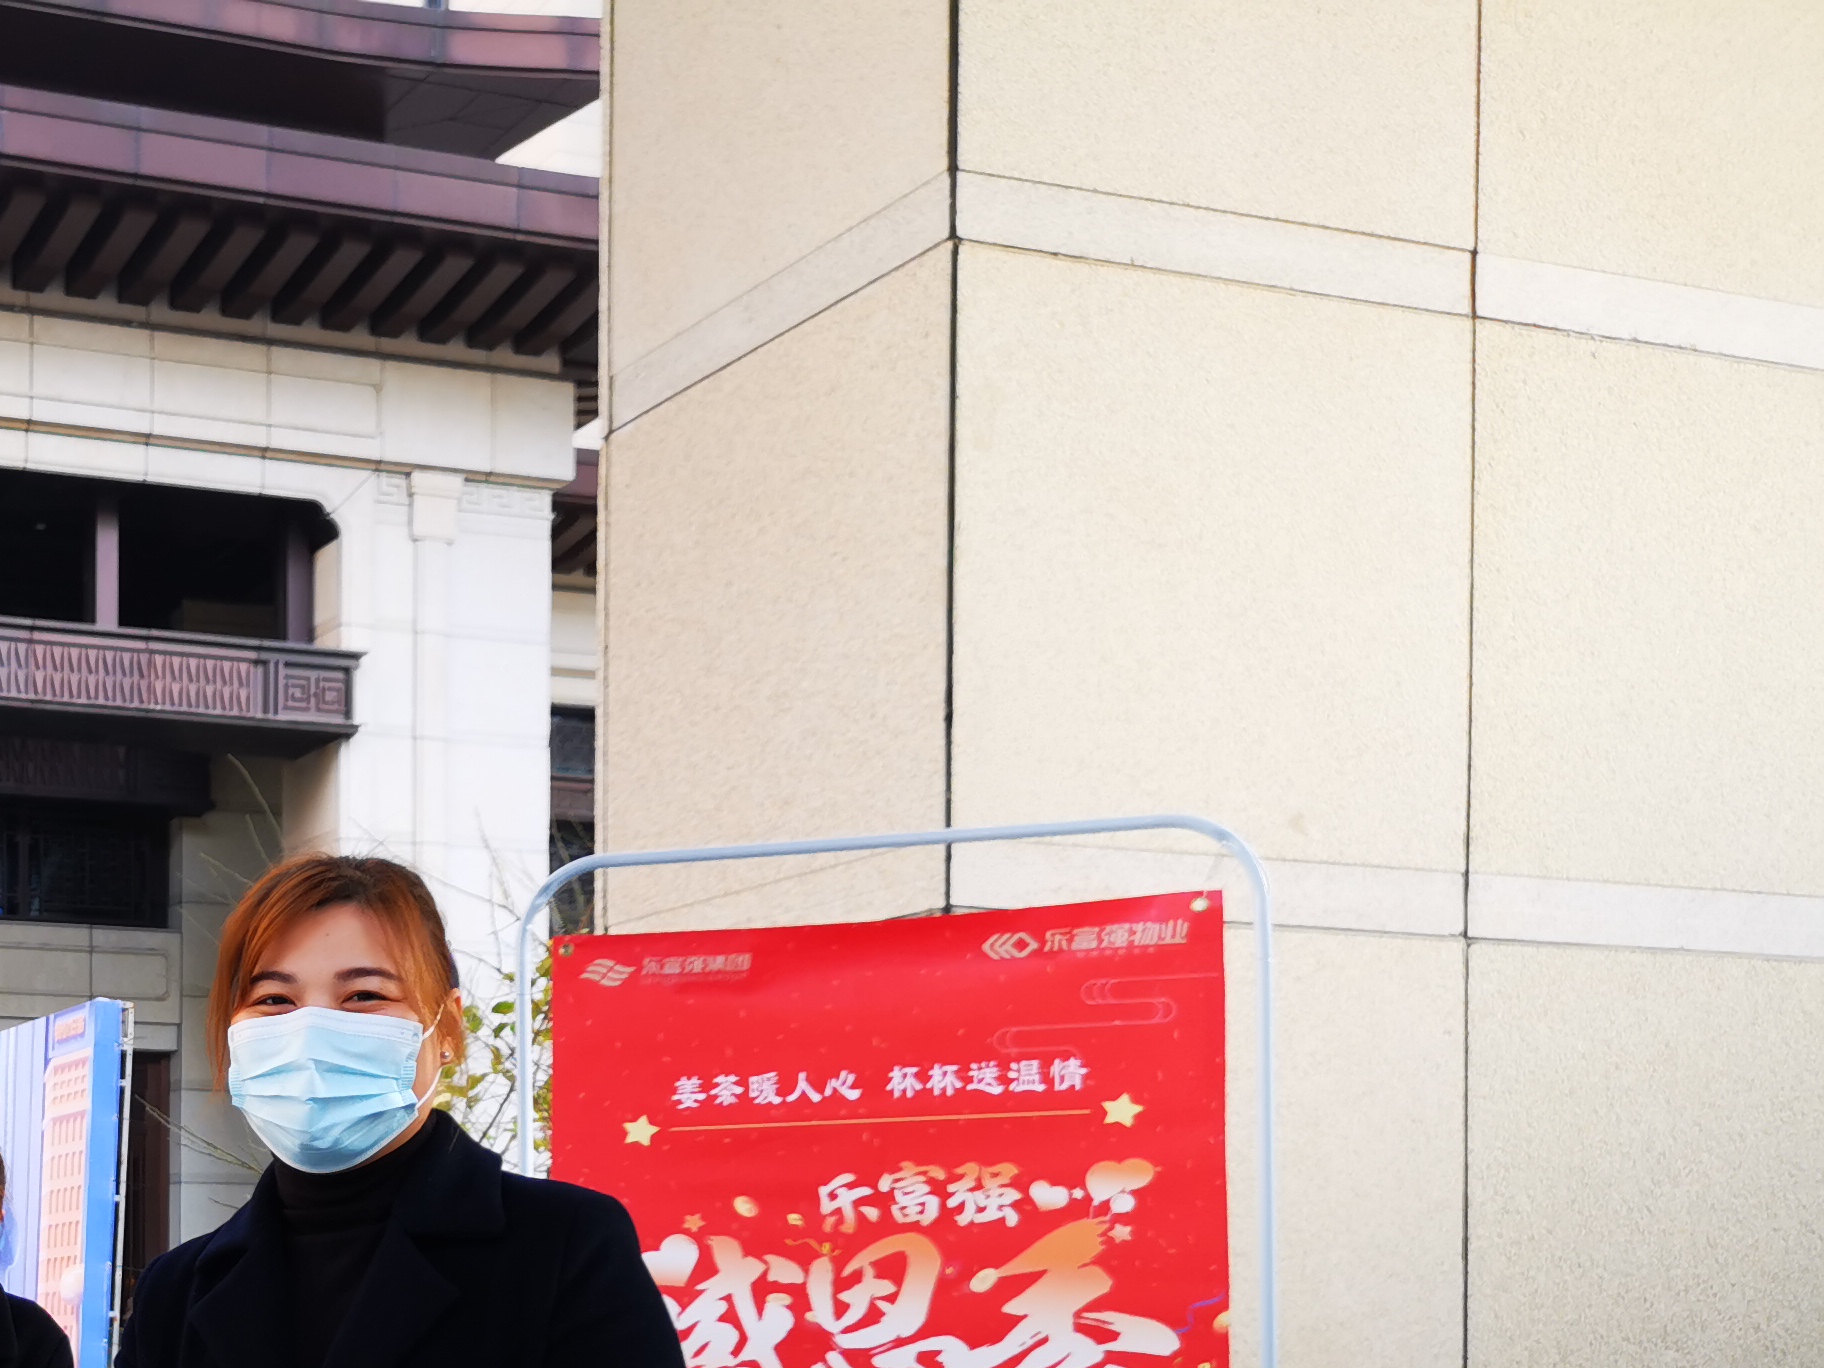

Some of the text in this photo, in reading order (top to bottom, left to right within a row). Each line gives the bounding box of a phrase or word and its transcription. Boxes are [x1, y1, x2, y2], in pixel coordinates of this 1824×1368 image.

[1043, 918, 1190, 953] 乐富强物业
[671, 1056, 1088, 1109] 姜茶暖人心 杯杯送温情
[817, 1160, 1020, 1233] 乐富强
